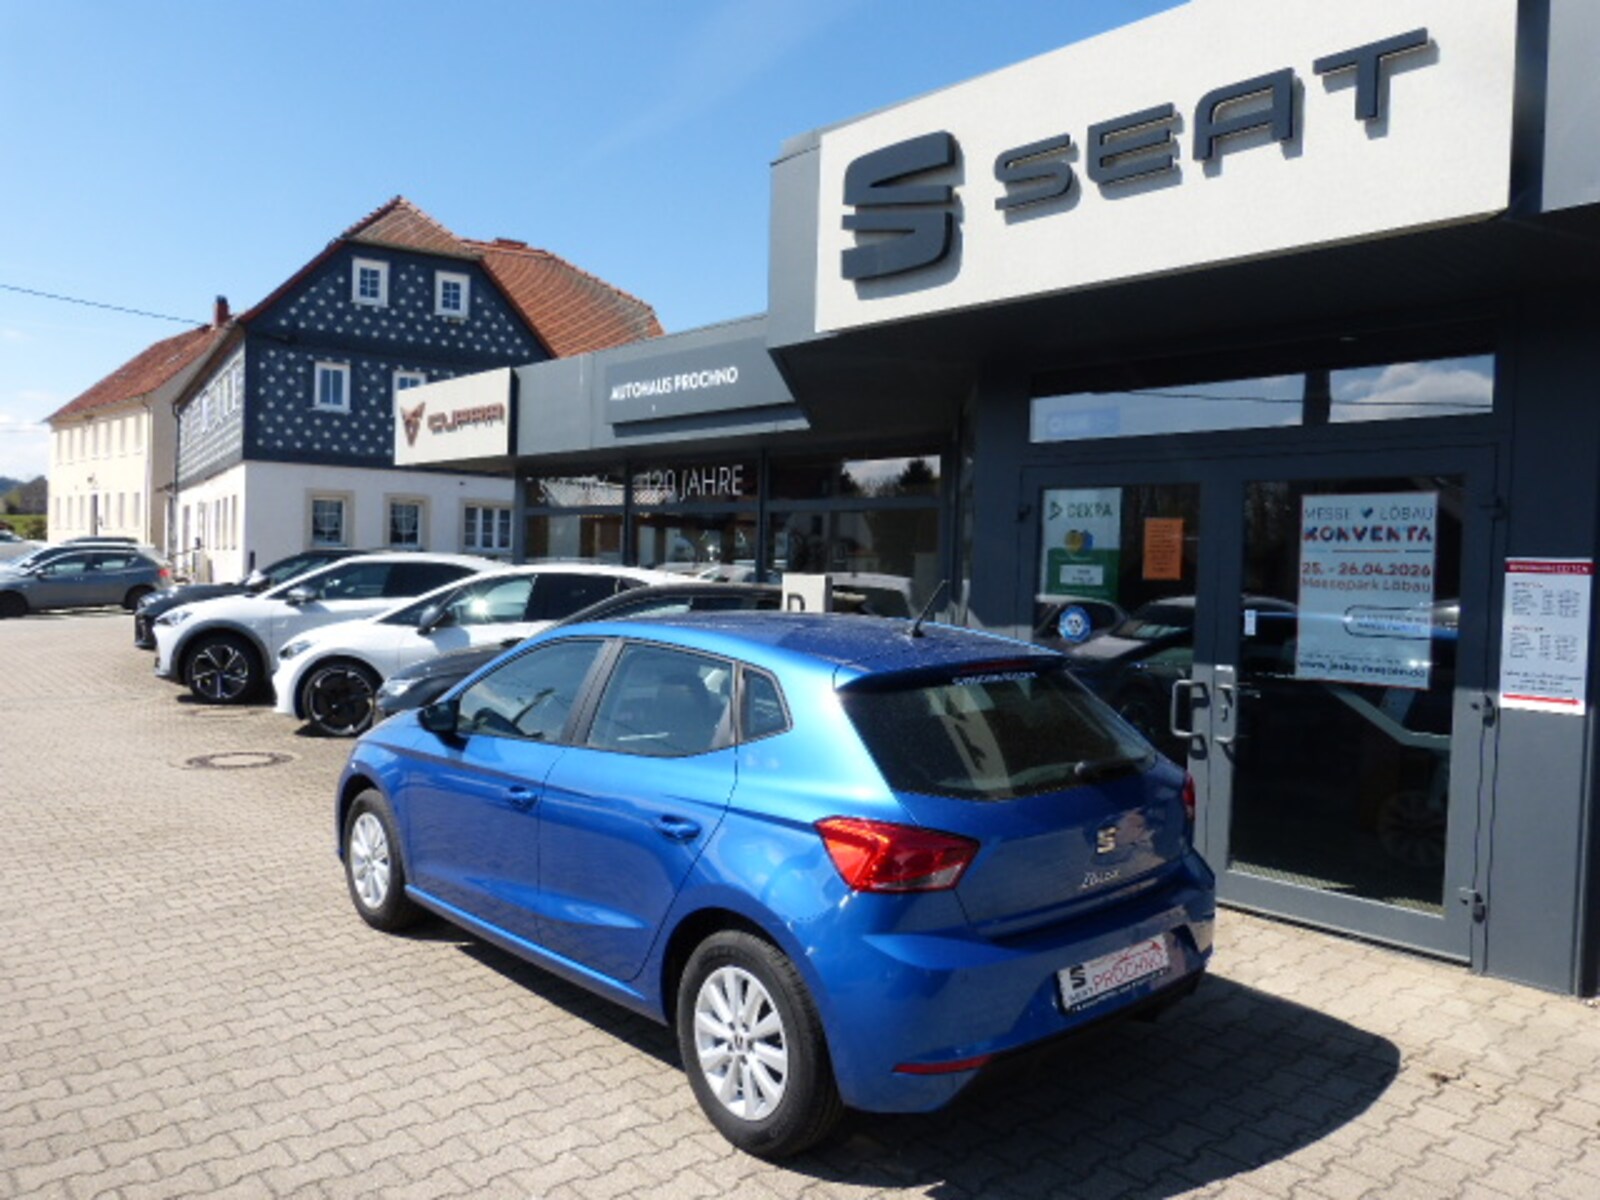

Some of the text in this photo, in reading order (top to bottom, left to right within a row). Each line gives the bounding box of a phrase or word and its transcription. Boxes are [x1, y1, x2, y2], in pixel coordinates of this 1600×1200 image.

[994, 27, 1430, 211] SEAT
[610, 376, 673, 401] AUTOHAUS
[679, 464, 744, 502] JAHRE
[1303, 525, 1433, 543] KONVENTA
[1338, 562, 1431, 577] 26.04.2026
